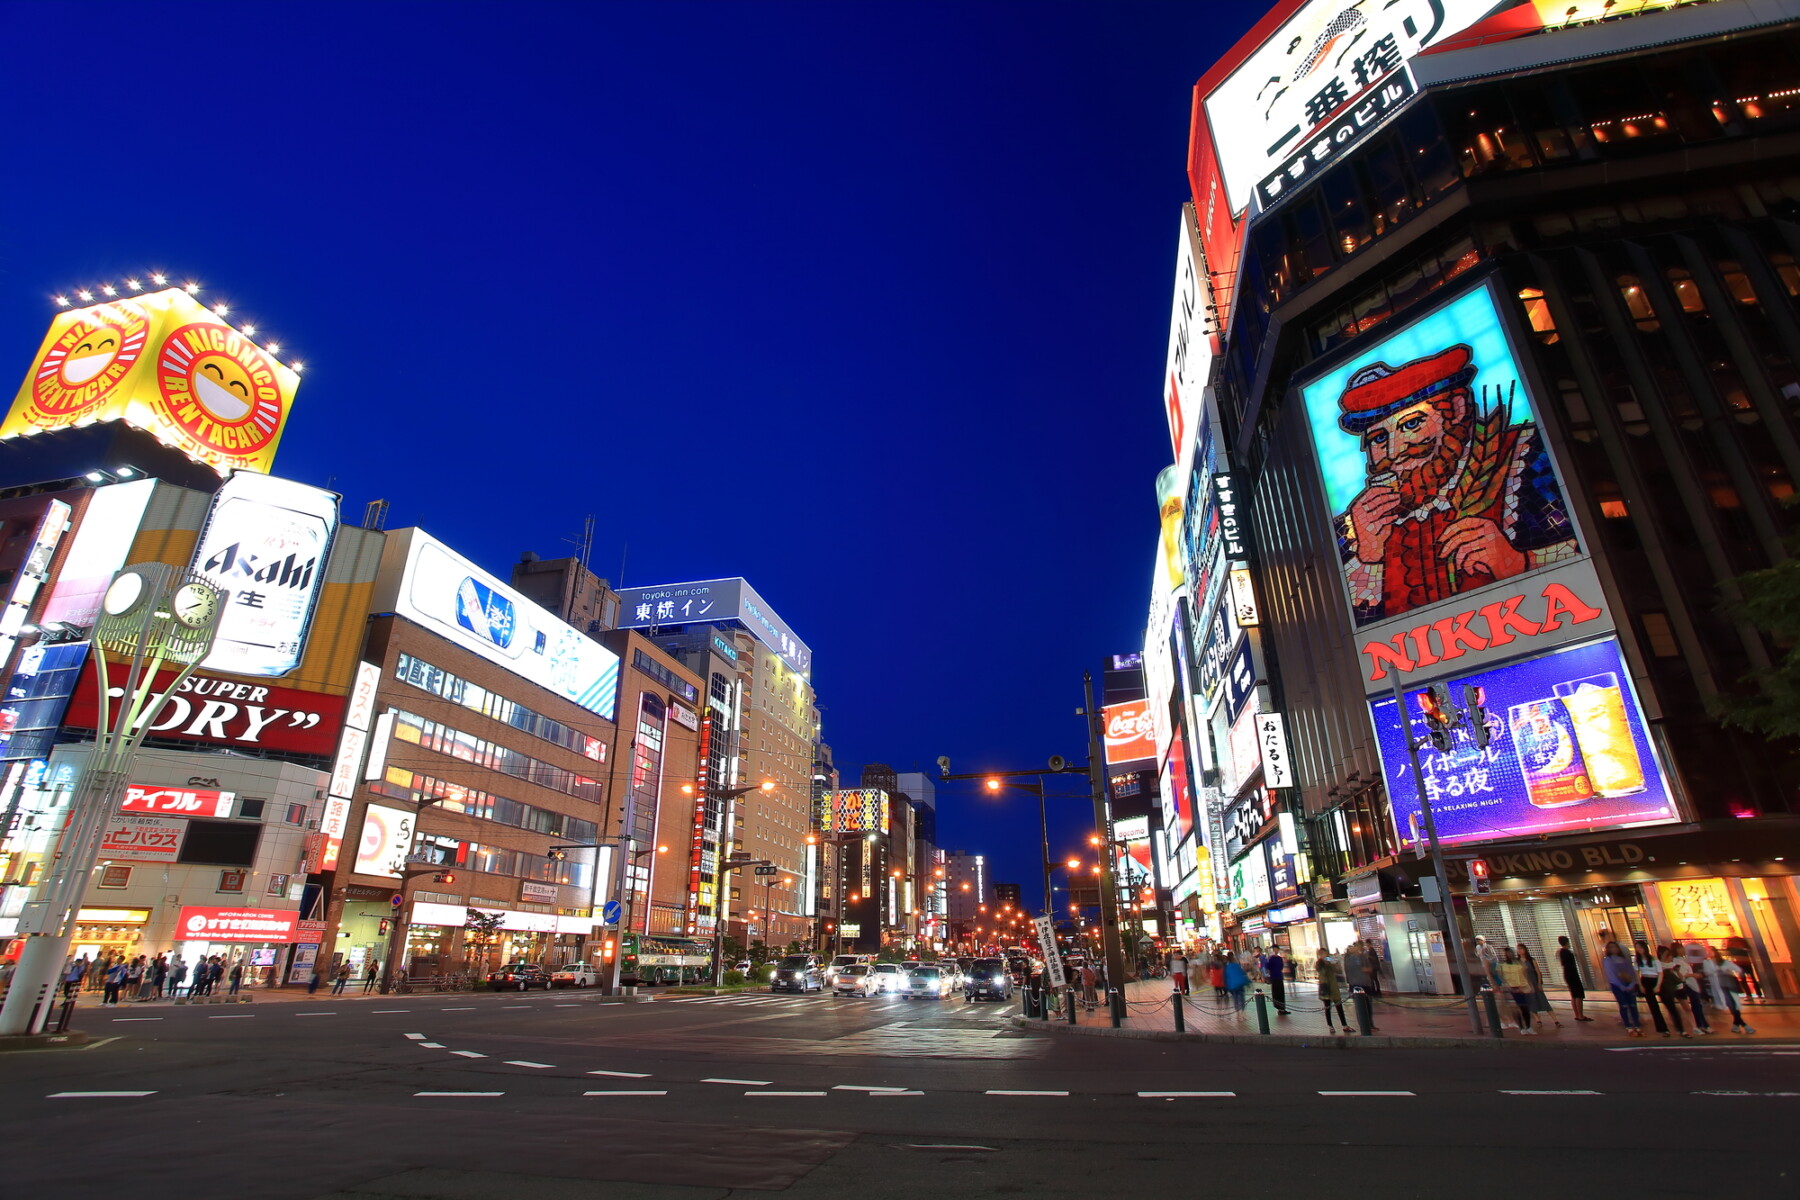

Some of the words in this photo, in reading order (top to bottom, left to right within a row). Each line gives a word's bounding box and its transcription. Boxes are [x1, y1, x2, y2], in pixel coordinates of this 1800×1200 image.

[1265, 83, 1404, 197] すすきのビル
[184, 328, 278, 401] NICONICO
[38, 363, 126, 410] RENTACAR
[163, 376, 264, 449] RENTACAR
[1215, 475, 1243, 554] すすきのビル
[204, 541, 316, 591] Asahi
[235, 590, 266, 609] 生
[635, 599, 714, 621] 東横イン
[1362, 583, 1602, 681] NIKKA
[177, 676, 269, 703] SUPER
[1109, 710, 1153, 737] Coca-Co
[1396, 745, 1501, 778] ハイボール
[122, 788, 203, 811] アイフル
[1414, 766, 1494, 800] 香る夜
[1480, 797, 1503, 807] NIGHT
[1118, 829, 1145, 838] docomo
[1444, 850, 1574, 879] SUUKINO
